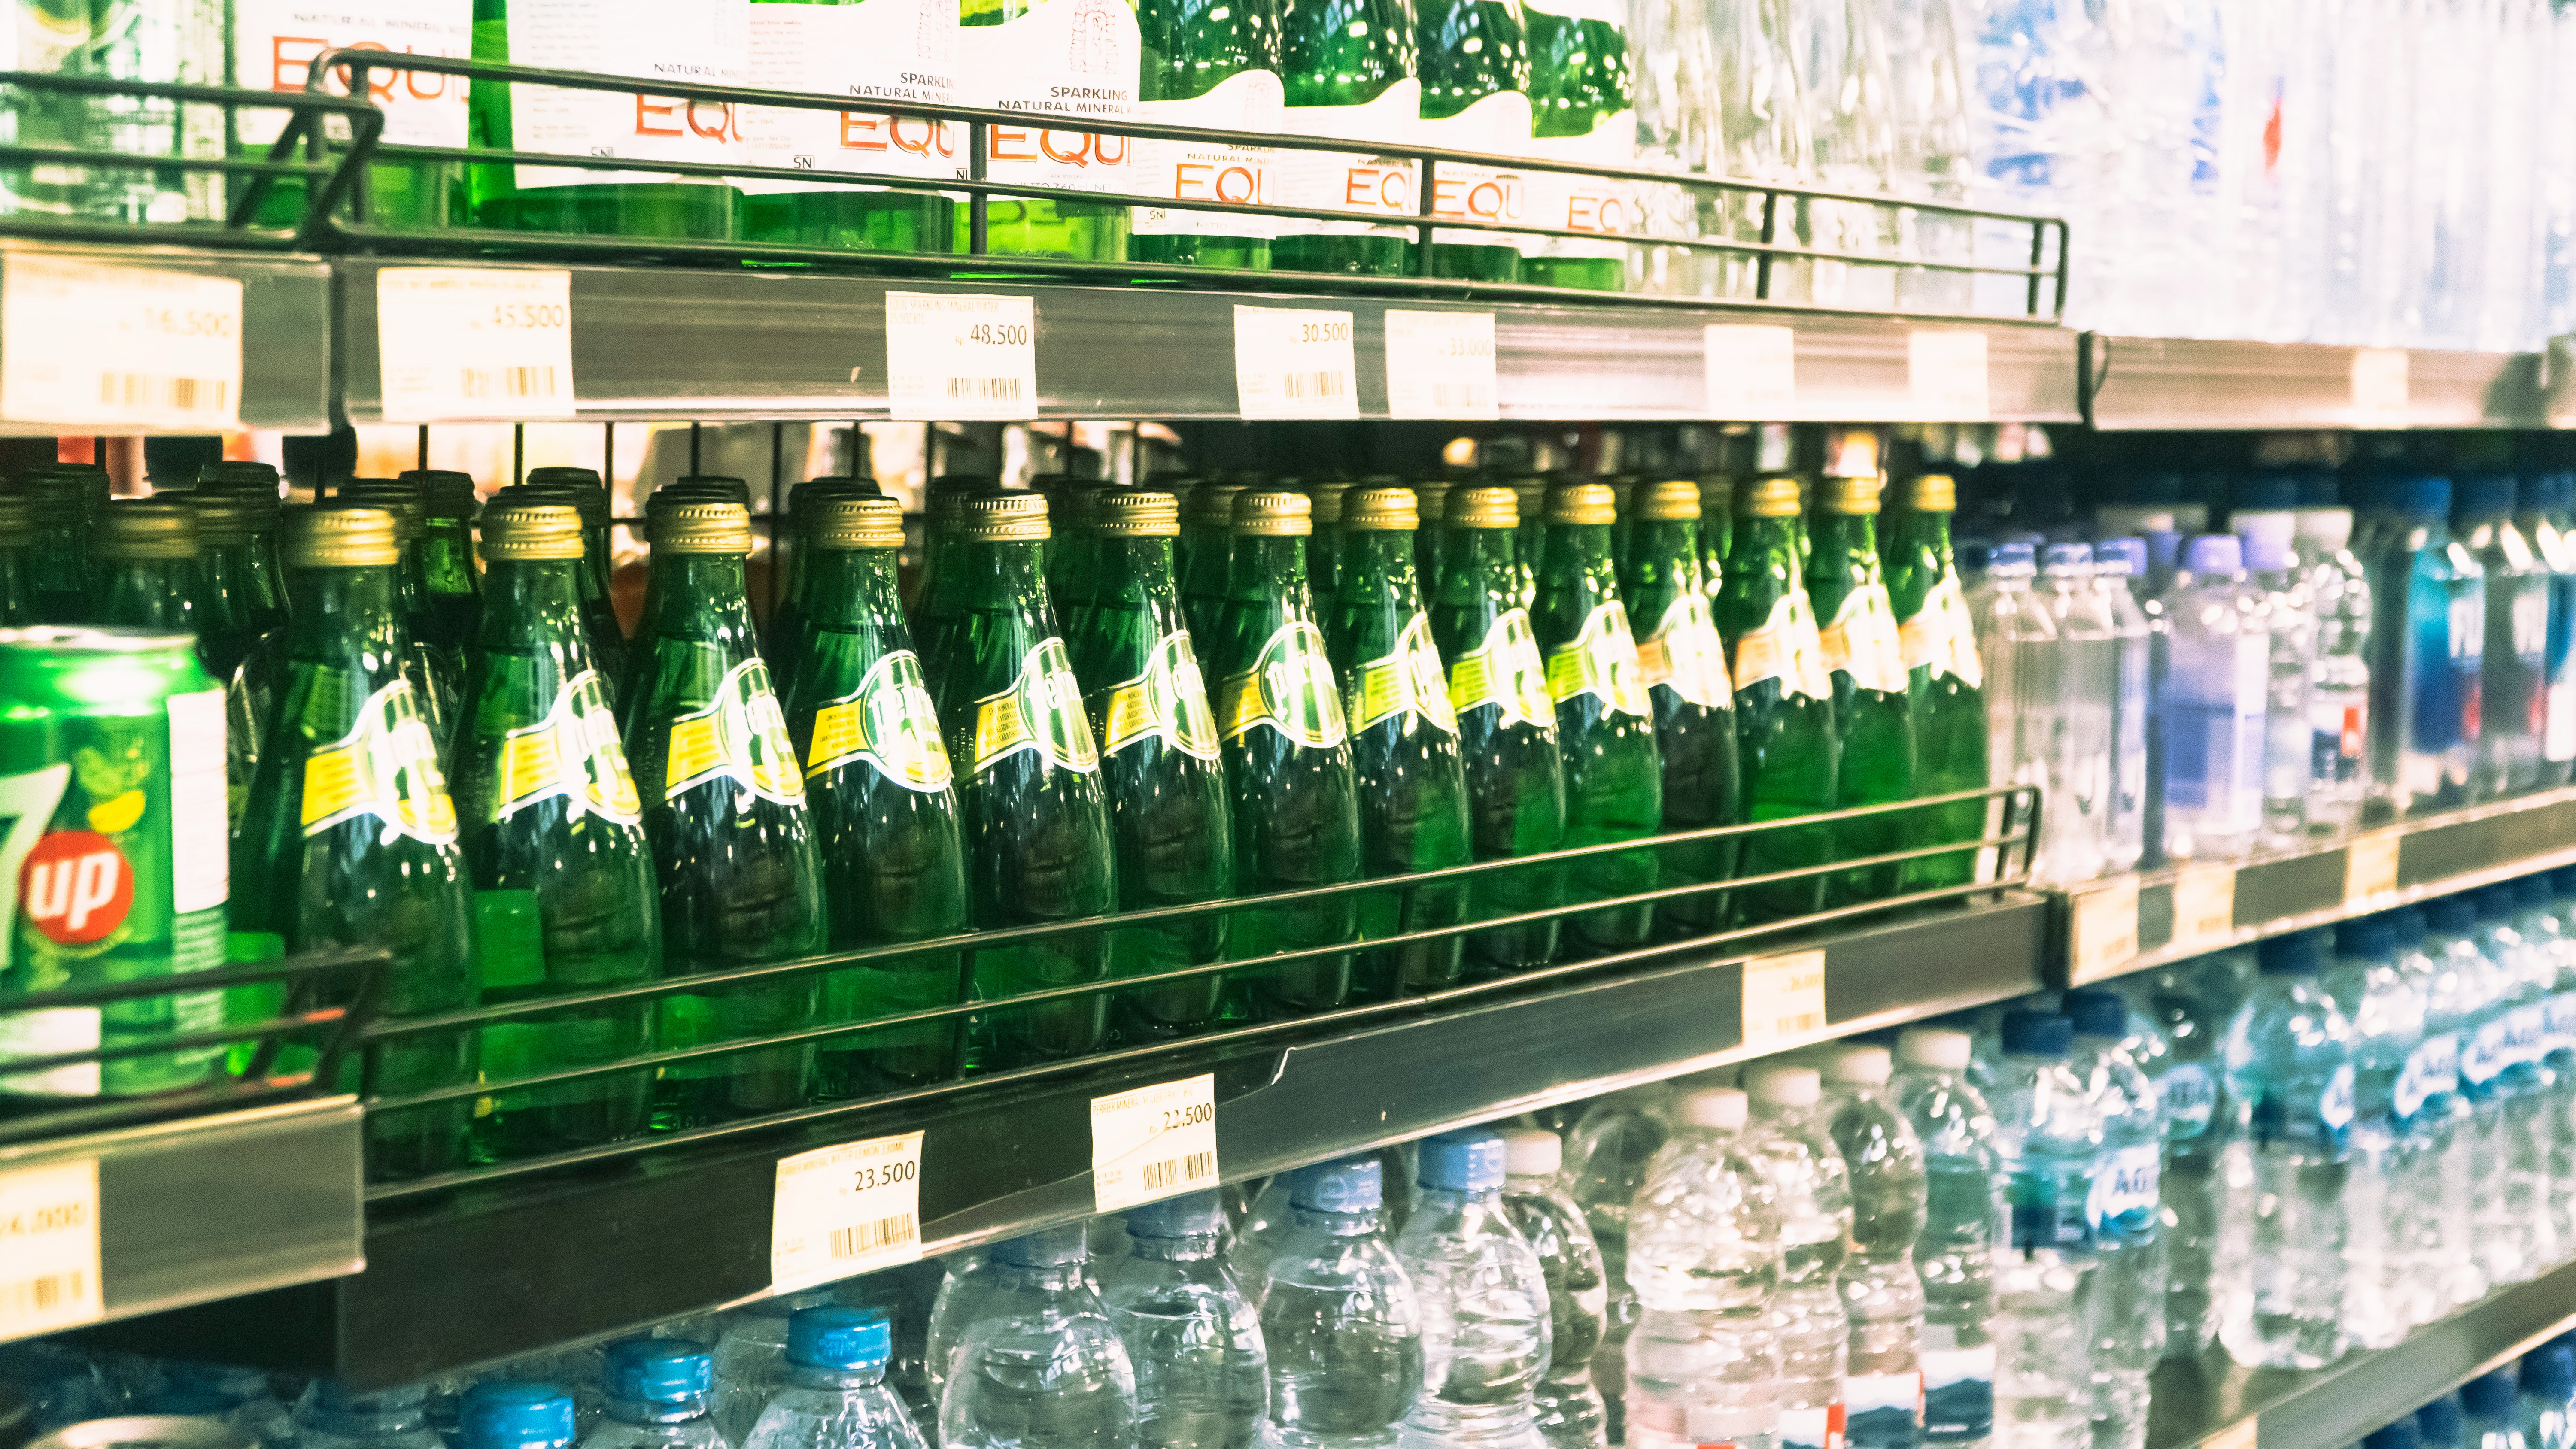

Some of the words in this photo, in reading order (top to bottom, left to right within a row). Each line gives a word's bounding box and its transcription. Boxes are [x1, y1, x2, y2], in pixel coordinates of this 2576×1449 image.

[653, 63, 717, 77] NATURAL
[850, 84, 917, 100] NATURAL
[1050, 86, 1128, 101] SPARKLING
[998, 100, 1071, 112] NATURAL
[1076, 103, 1124, 114] MINERAL
[793, 155, 815, 169] SNI
[1187, 153, 1241, 163] NATURAL
[1149, 209, 1166, 220] SNI
[1196, 221, 1228, 231] NETTO
[490, 303, 565, 329] 45.500
[970, 324, 1027, 346] 48.500
[1302, 322, 1349, 343] 30.500
[1450, 337, 1492, 356] 33.000
[27, 851, 120, 931] up
[1093, 1102, 1115, 1116] PERRIER
[854, 1145, 879, 1160] LEMON
[854, 1160, 916, 1193] 23.500
